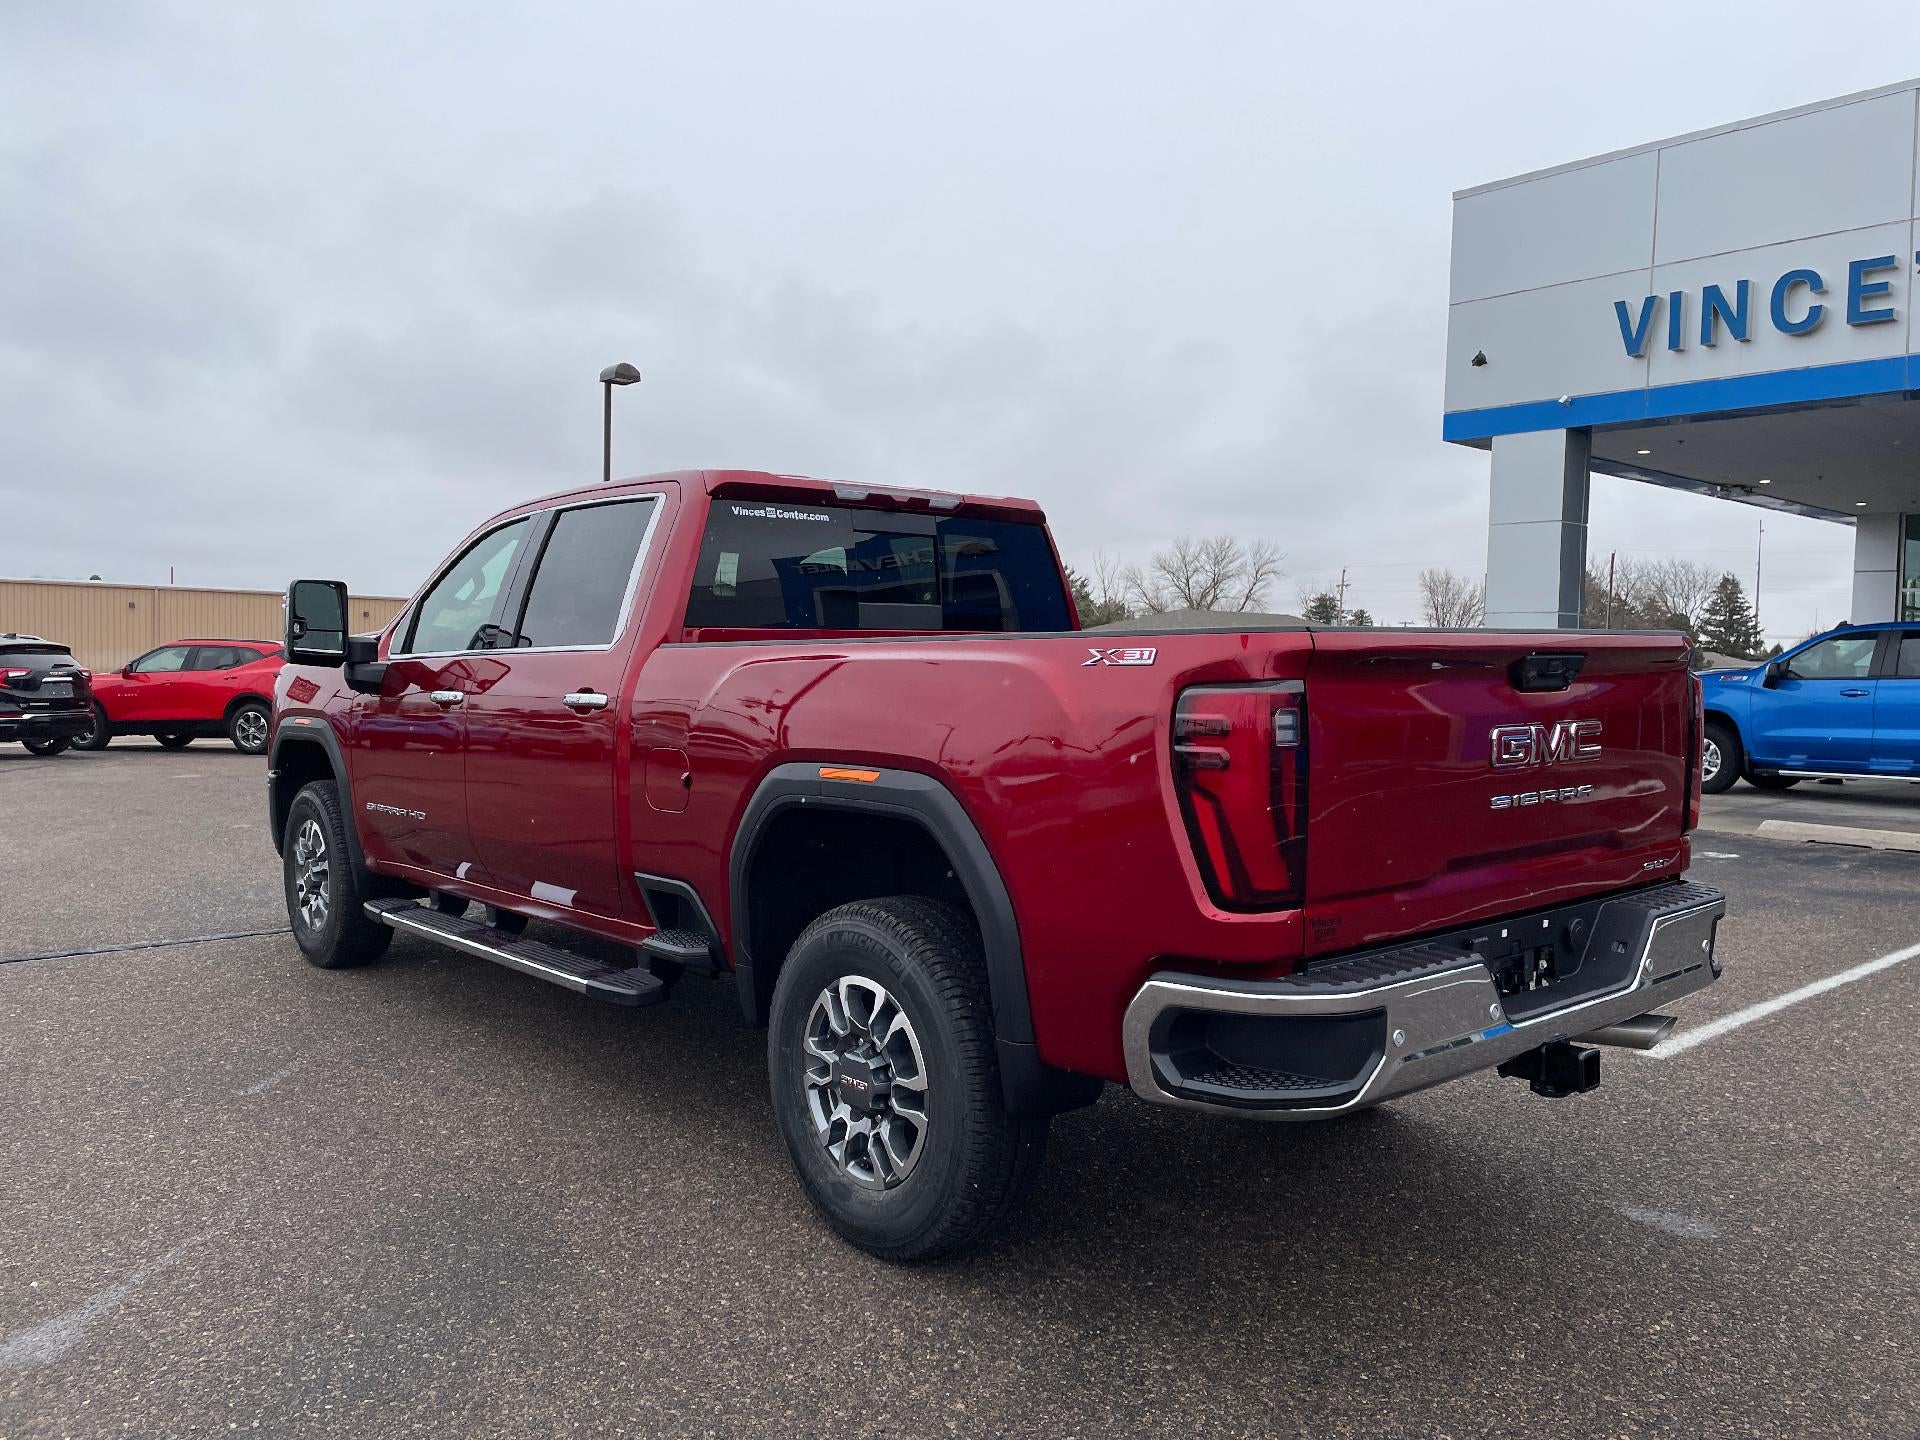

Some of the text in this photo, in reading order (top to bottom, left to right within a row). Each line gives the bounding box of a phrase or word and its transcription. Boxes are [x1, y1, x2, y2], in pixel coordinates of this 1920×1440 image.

[1081, 648, 1157, 666] X31
[1489, 719, 1602, 769] GMC
[1490, 785, 1594, 809] SIERRA
[366, 802, 426, 820] SIERRA HD
